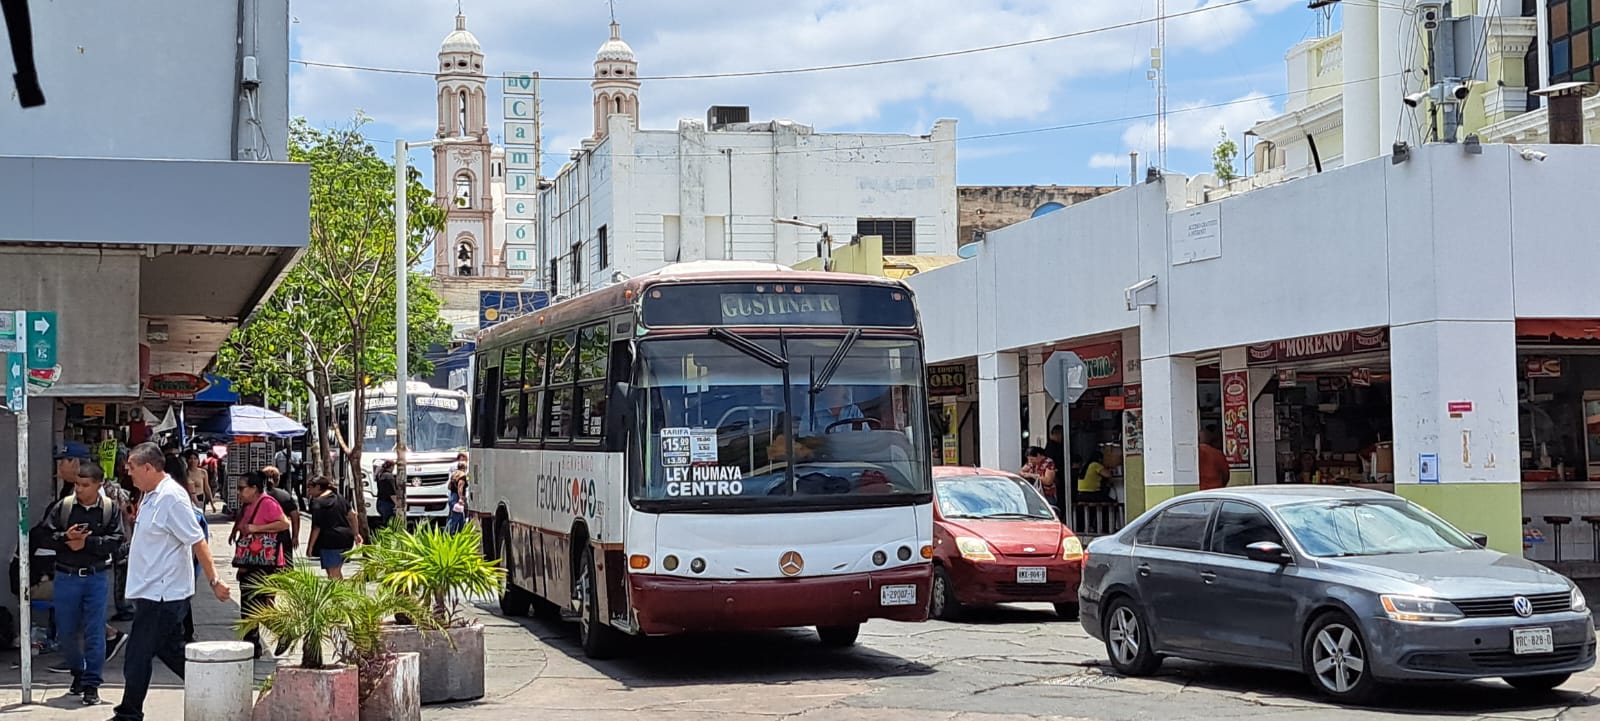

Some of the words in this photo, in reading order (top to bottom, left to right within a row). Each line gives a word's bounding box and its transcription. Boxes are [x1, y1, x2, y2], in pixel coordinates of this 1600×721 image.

[512, 100, 529, 261] Campeón
[1280, 332, 1350, 358] "MORENO"
[930, 373, 964, 387] ORO
[666, 468, 690, 481] LEY
[693, 466, 742, 481] HUMAYA
[667, 481, 743, 497] CENTRO
